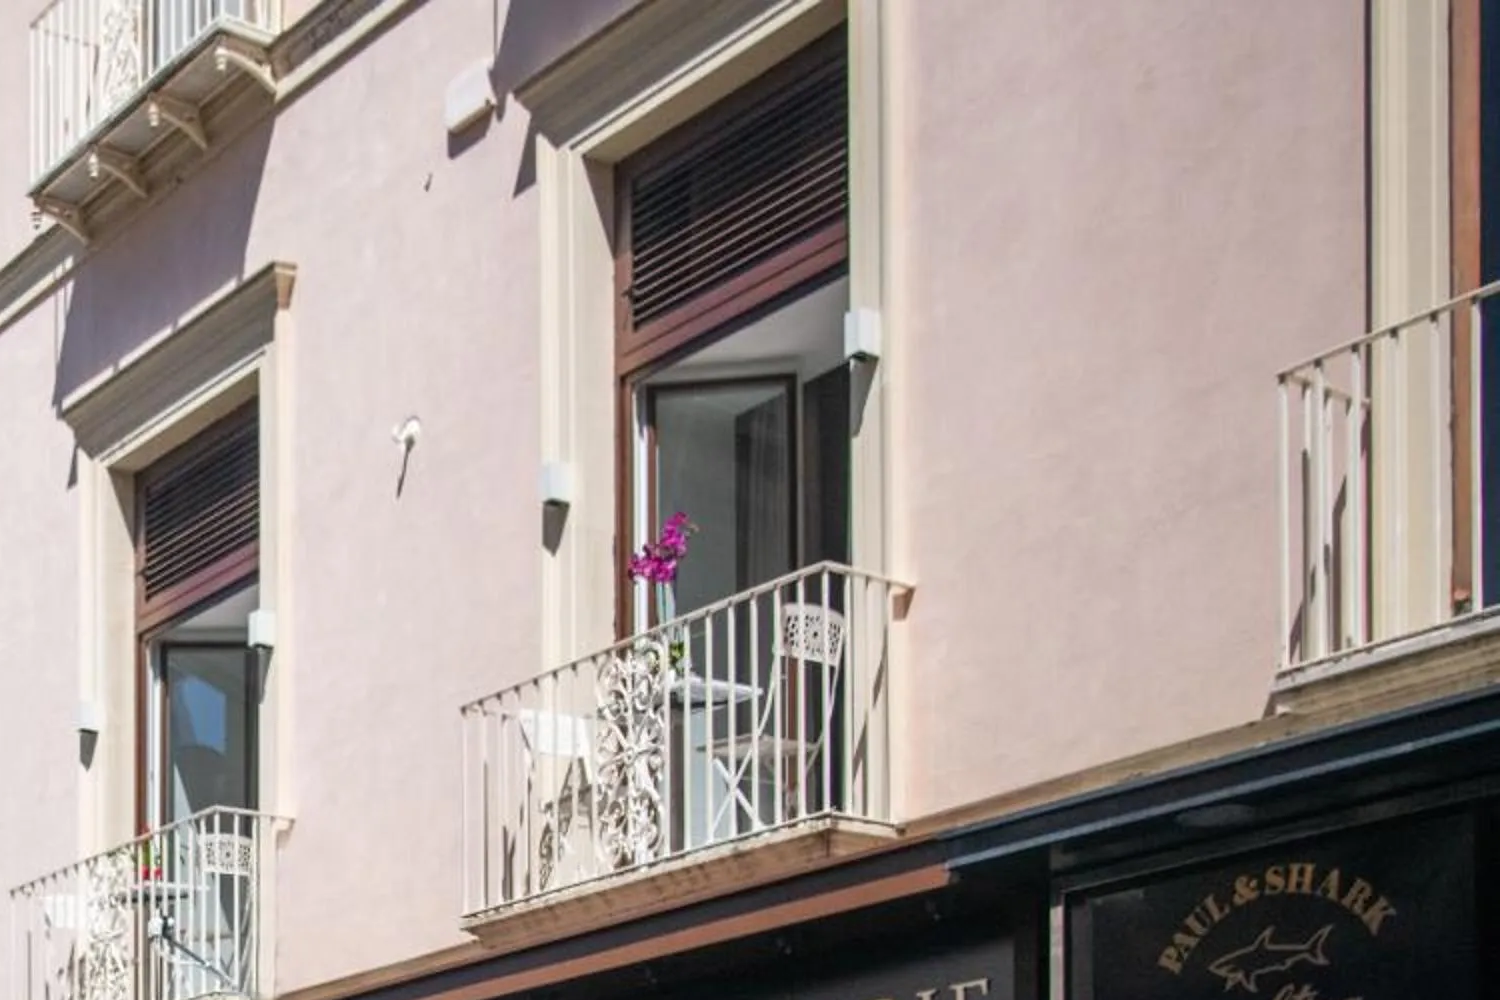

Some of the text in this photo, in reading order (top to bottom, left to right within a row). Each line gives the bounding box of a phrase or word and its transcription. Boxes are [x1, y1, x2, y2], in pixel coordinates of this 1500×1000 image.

[1157, 861, 1397, 975] PAUL & SHARK
